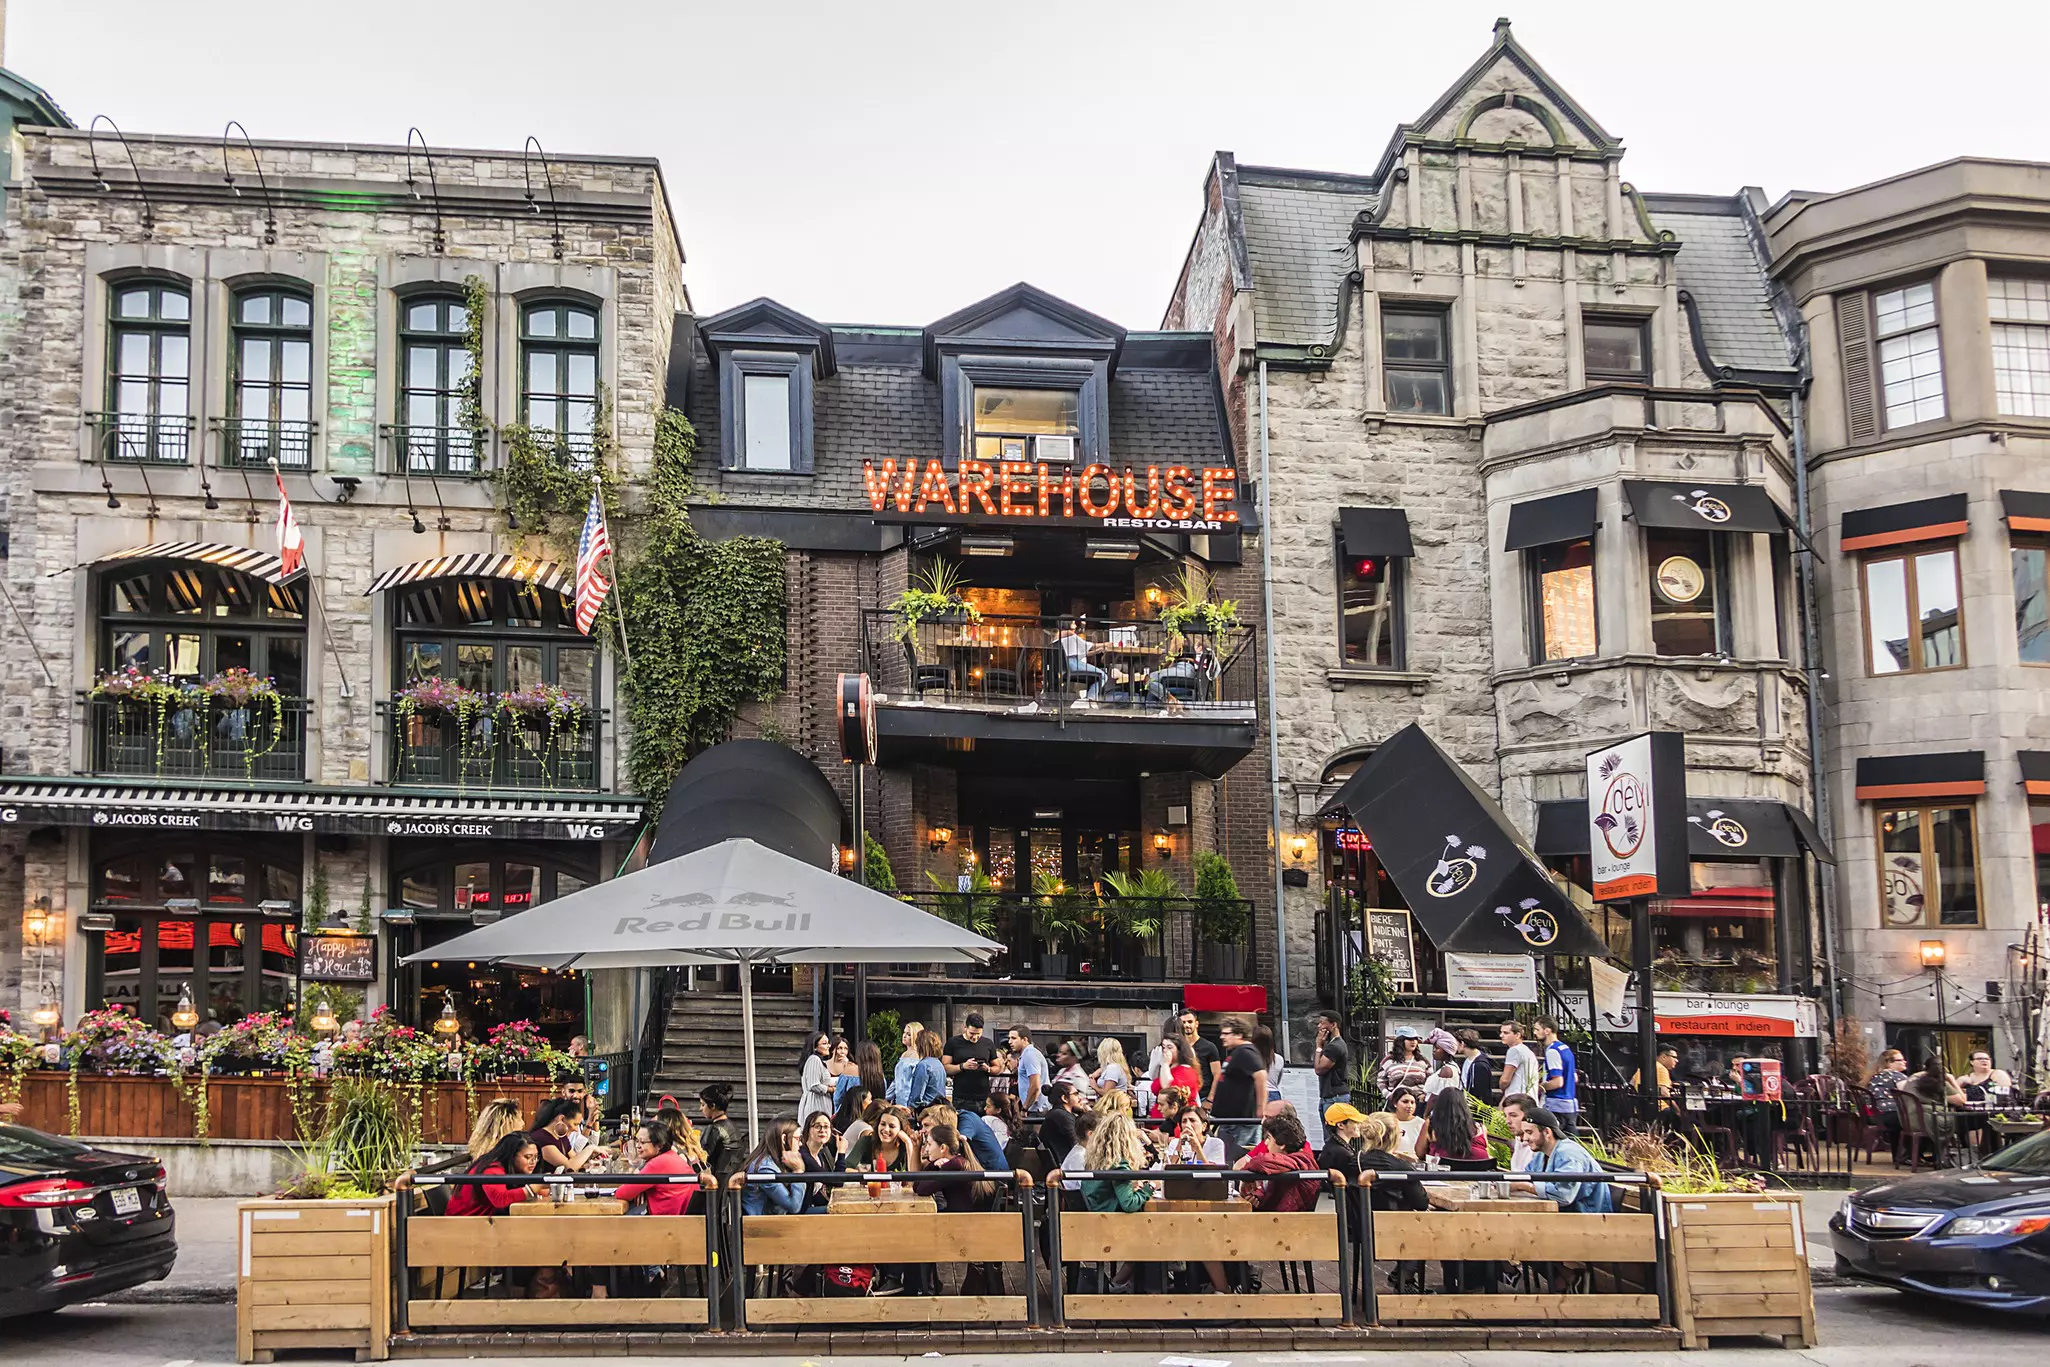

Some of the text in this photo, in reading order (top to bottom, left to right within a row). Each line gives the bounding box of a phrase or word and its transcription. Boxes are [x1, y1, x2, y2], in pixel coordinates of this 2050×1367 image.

[863, 457, 1239, 522] WAREHOUSE
[1103, 518, 1222, 530] RESTO-BAR
[1613, 778, 1650, 815] dévi
[0, 808, 18, 822] G
[109, 812, 200, 827] JACOB'S CREEK
[403, 823, 492, 835] JACOB'S CREEK
[1597, 861, 1631, 875] bar lounge
[1598, 879, 1652, 895] restaurant indien
[613, 912, 811, 935] Red Bull
[1373, 925, 1408, 937] INDIENNE
[308, 939, 348, 958] Happy
[1372, 938, 1394, 948] PINTE
[322, 958, 352, 975] Hour
[1564, 995, 1583, 1005] bar
[1687, 999, 1750, 1012] bar lounge
[1670, 1021, 1771, 1032] restaurant indien
